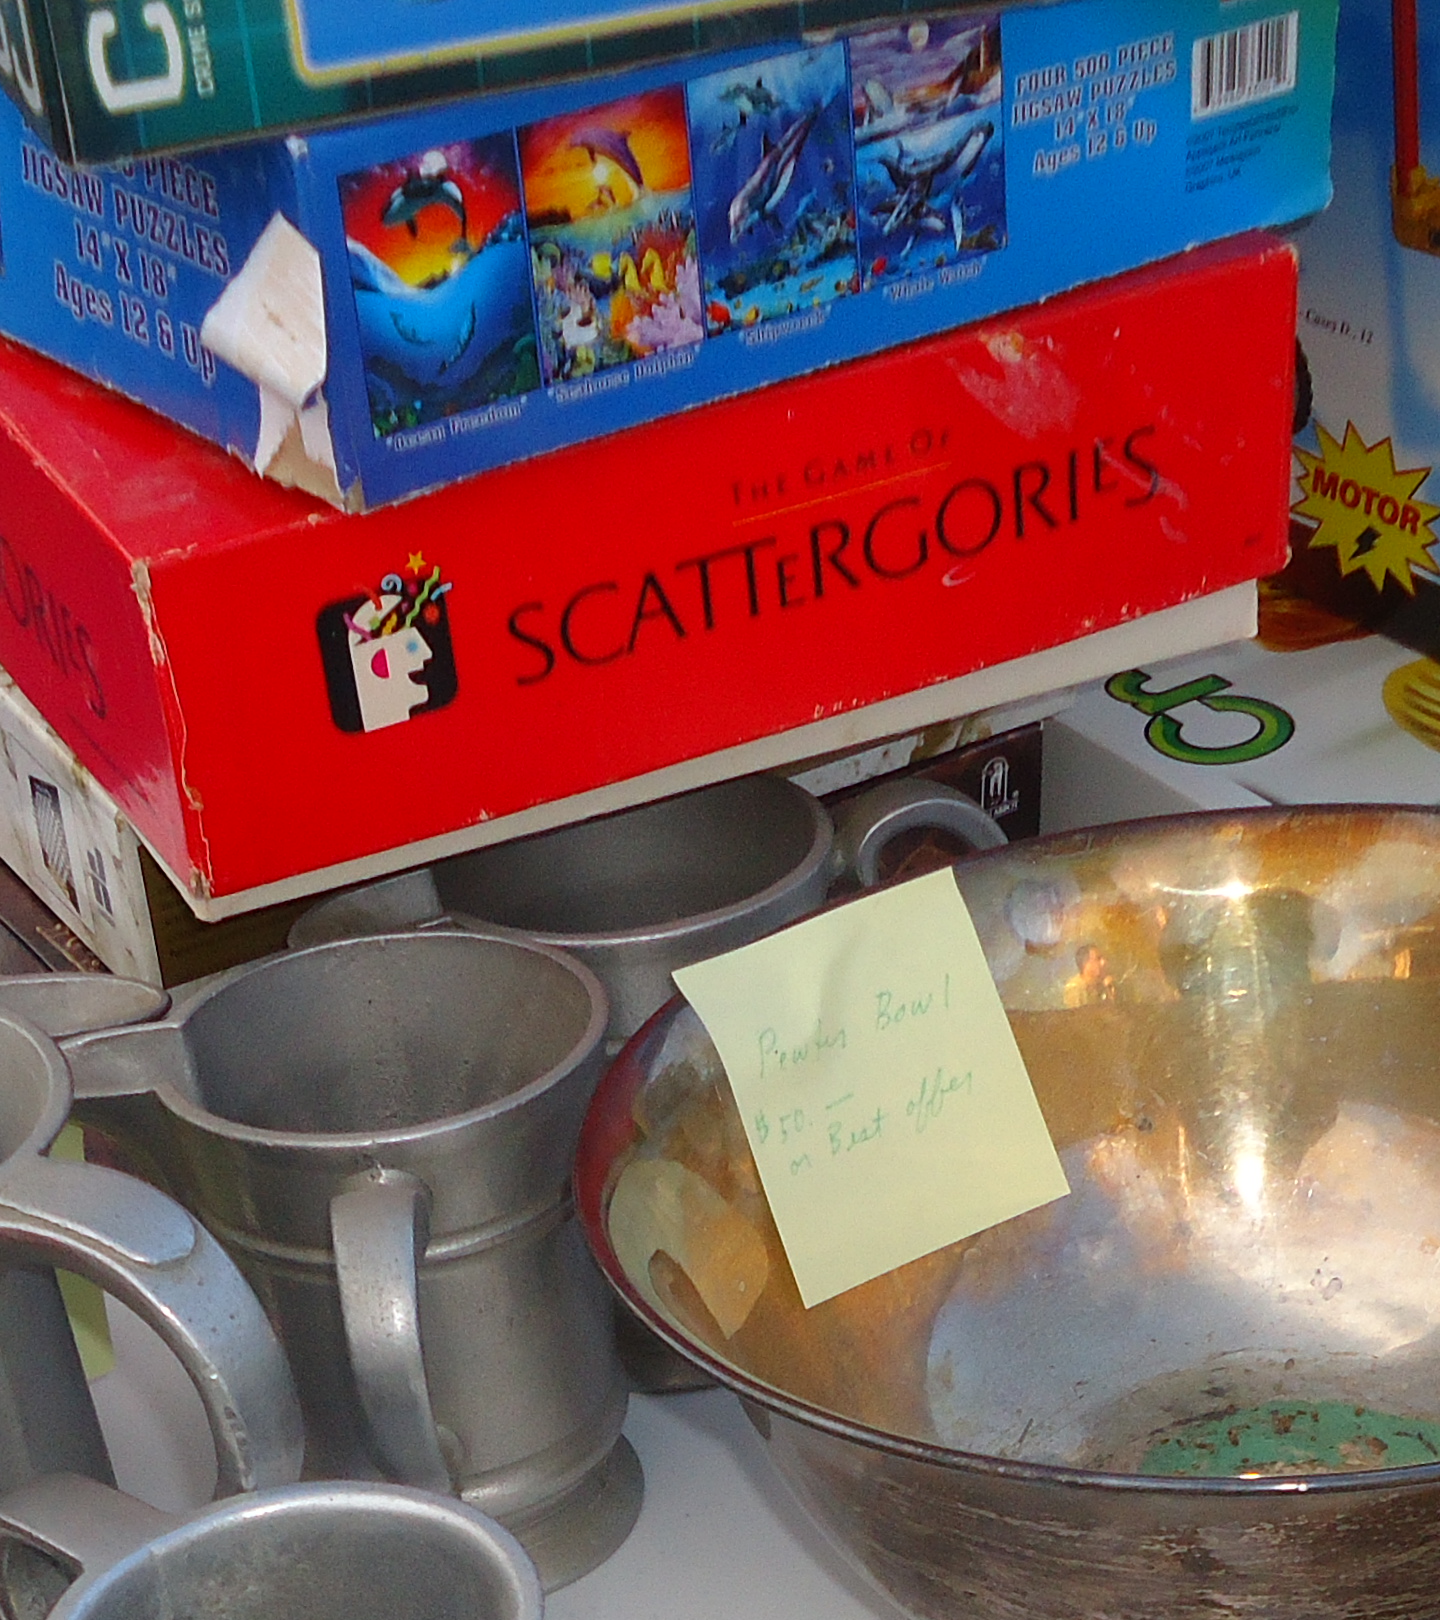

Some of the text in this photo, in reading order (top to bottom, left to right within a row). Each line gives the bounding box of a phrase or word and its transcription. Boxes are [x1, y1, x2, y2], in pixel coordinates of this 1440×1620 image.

[1012, 85, 1083, 128] JIGSAW
[1090, 59, 1176, 103] PUZZLES
[1016, 30, 1174, 98] FOUR 500 PIECE
[1033, 145, 1081, 176] Ages
[1087, 132, 1108, 159] 12
[1133, 118, 1157, 144] Up
[21, 141, 231, 276] JIGSAW PUZZLES
[143, 156, 220, 218] PIECE
[114, 238, 133, 283] X
[55, 259, 113, 325] Ages
[119, 292, 150, 345] 12
[156, 310, 175, 358] &
[181, 322, 217, 386] Up
[803, 447, 896, 487] GAME
[1312, 466, 1422, 535] MOTOR
[507, 424, 1162, 687] SCATTERGORIES
[876, 972, 950, 1031] Bowl
[829, 1107, 885, 1156] Best
